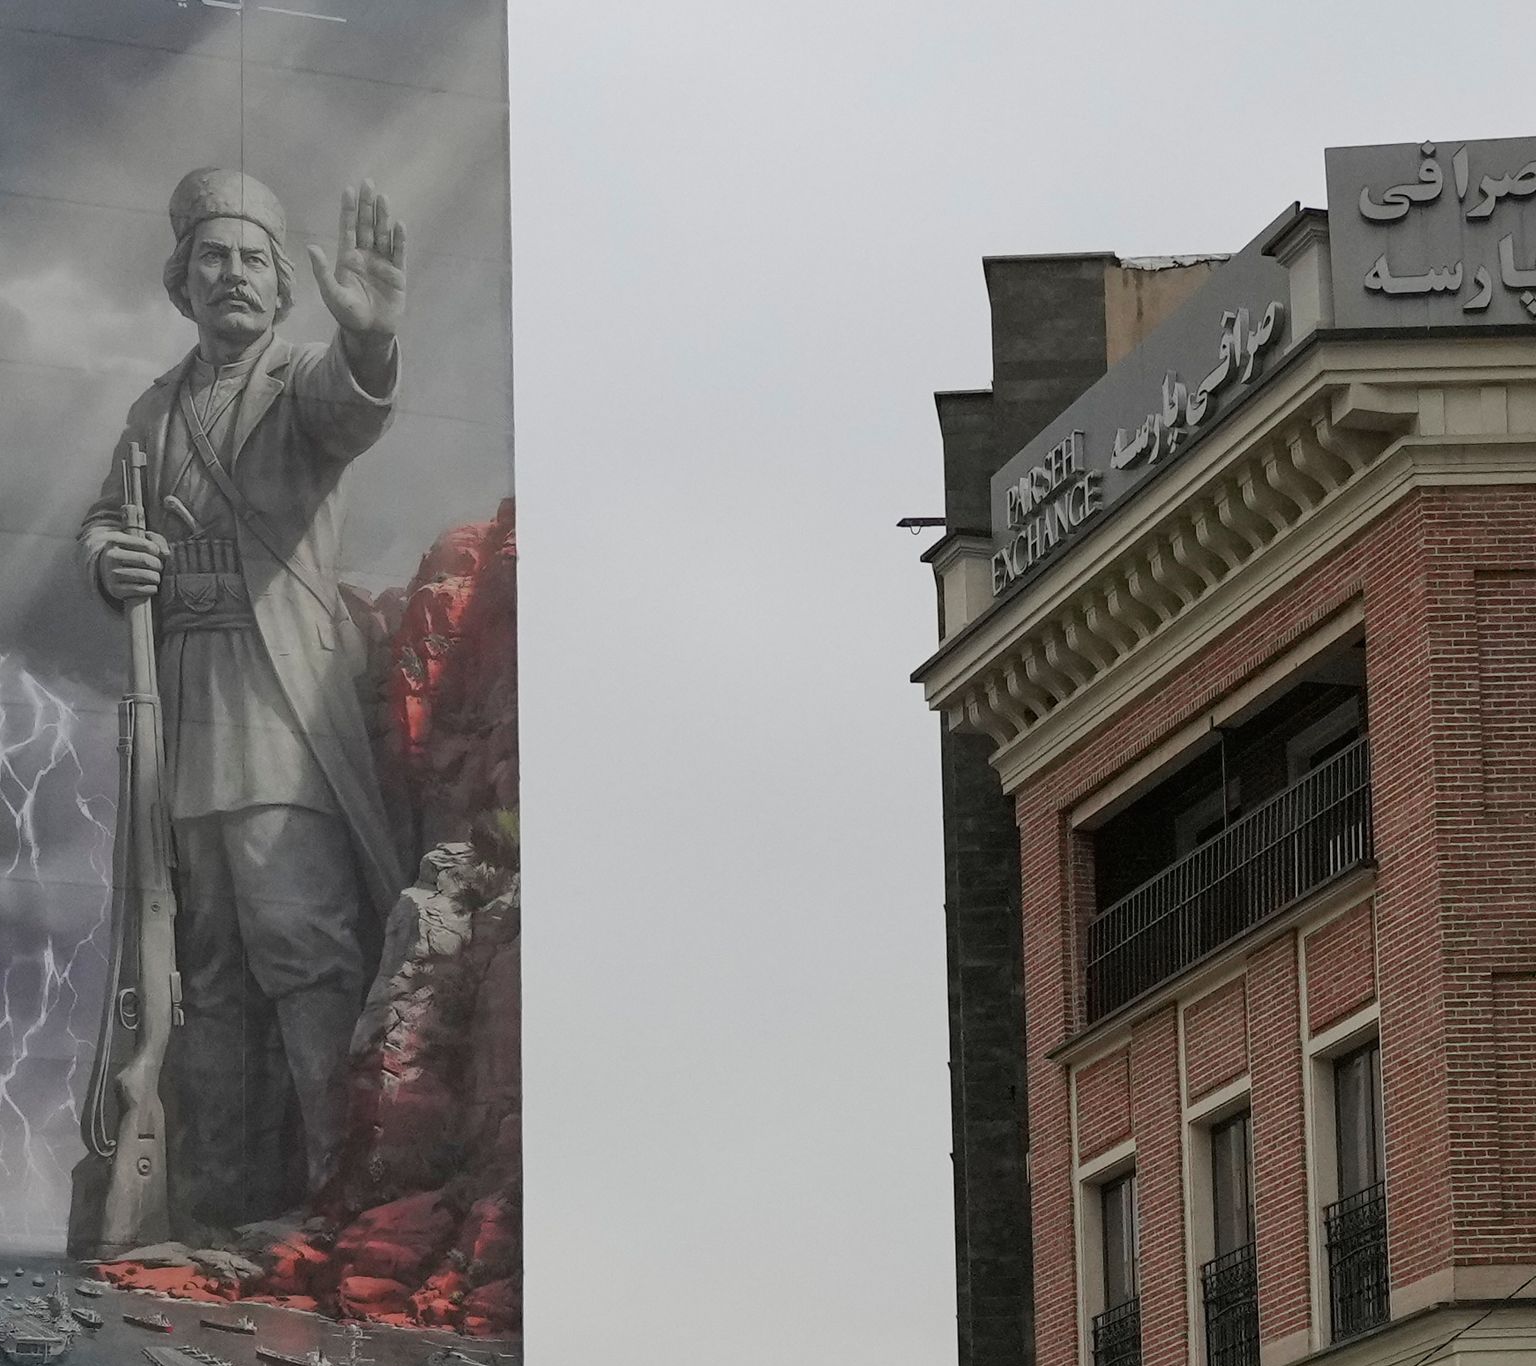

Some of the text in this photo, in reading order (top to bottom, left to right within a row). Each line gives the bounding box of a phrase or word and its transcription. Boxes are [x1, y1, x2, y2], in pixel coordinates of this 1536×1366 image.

[1110, 301, 1284, 470] صرافی پارسه
[991, 469, 1103, 597] EXCHANGE
[1006, 429, 1085, 529] PARSEH
